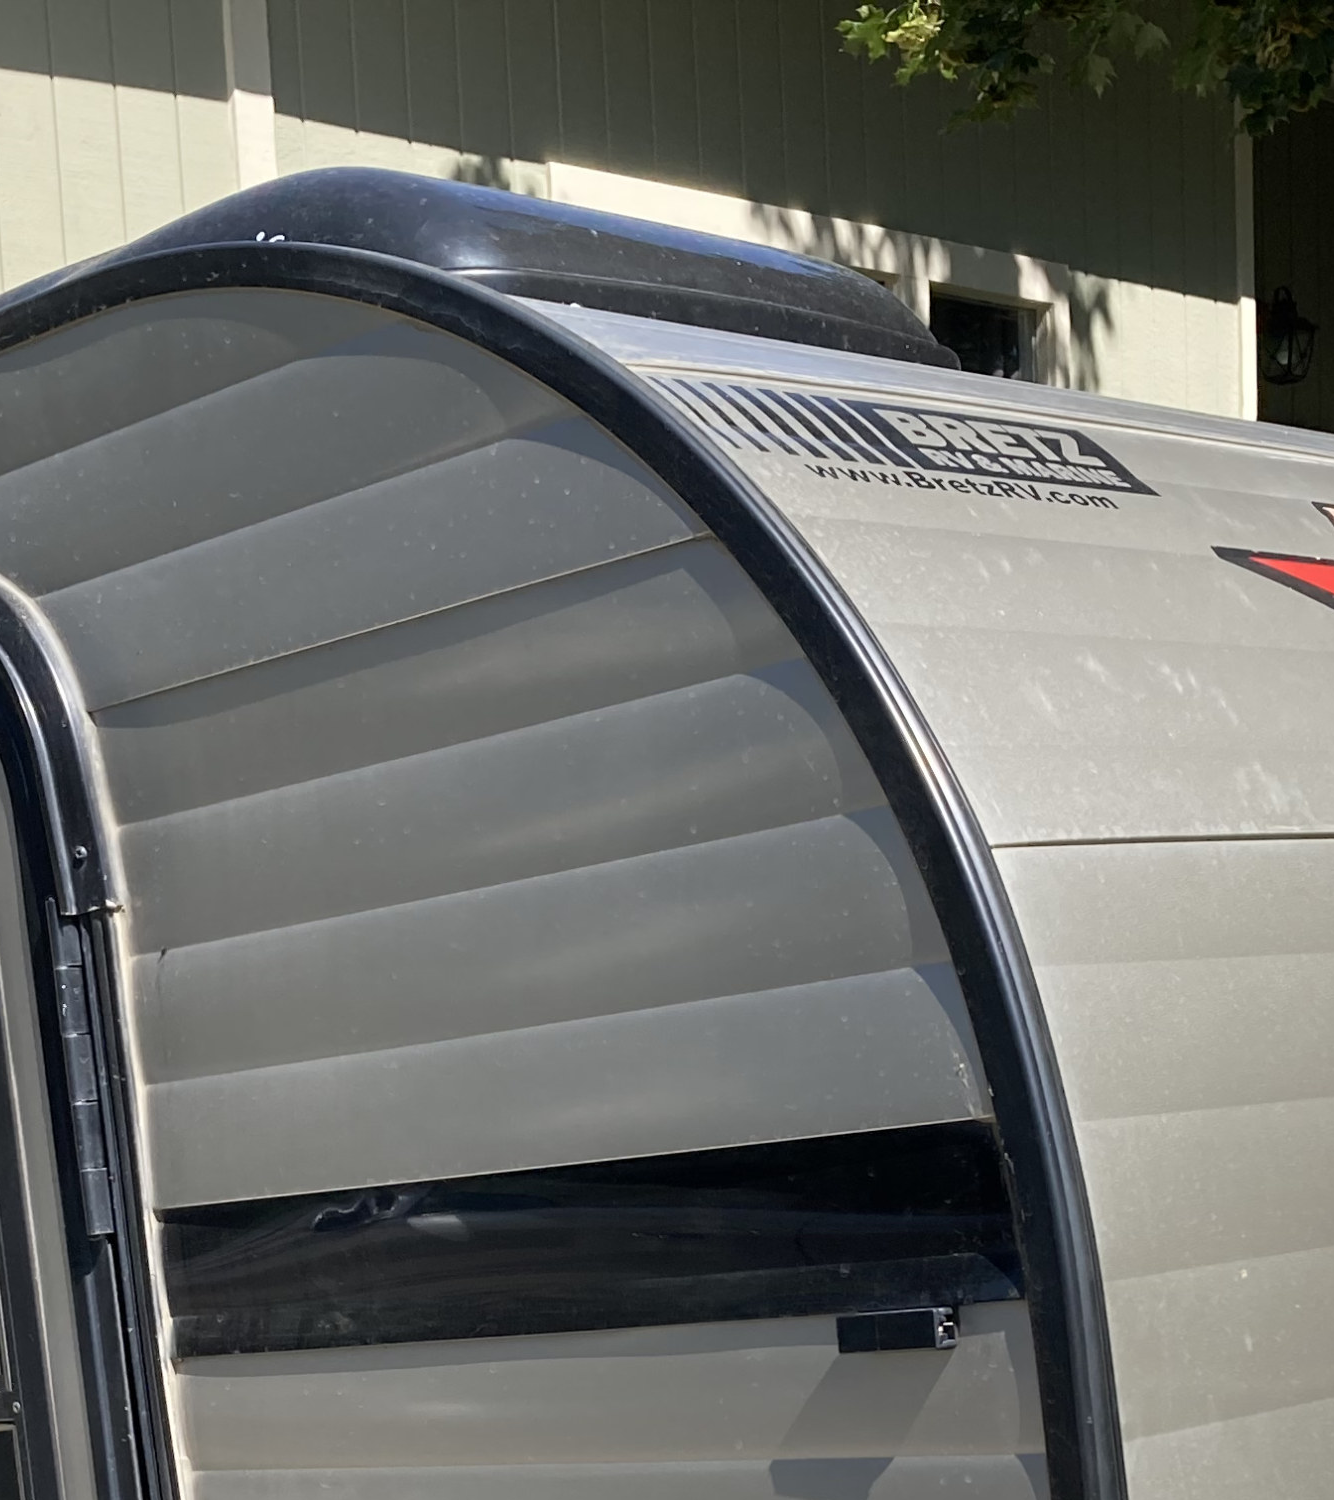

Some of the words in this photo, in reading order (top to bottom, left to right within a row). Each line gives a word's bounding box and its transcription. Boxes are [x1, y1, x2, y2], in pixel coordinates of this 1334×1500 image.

[872, 408, 1107, 467] BRETZ
[805, 464, 1119, 509] www.BretzRV.com
[918, 448, 974, 470] RV
[971, 454, 1009, 474] &
[998, 457, 1131, 488] MARINE
